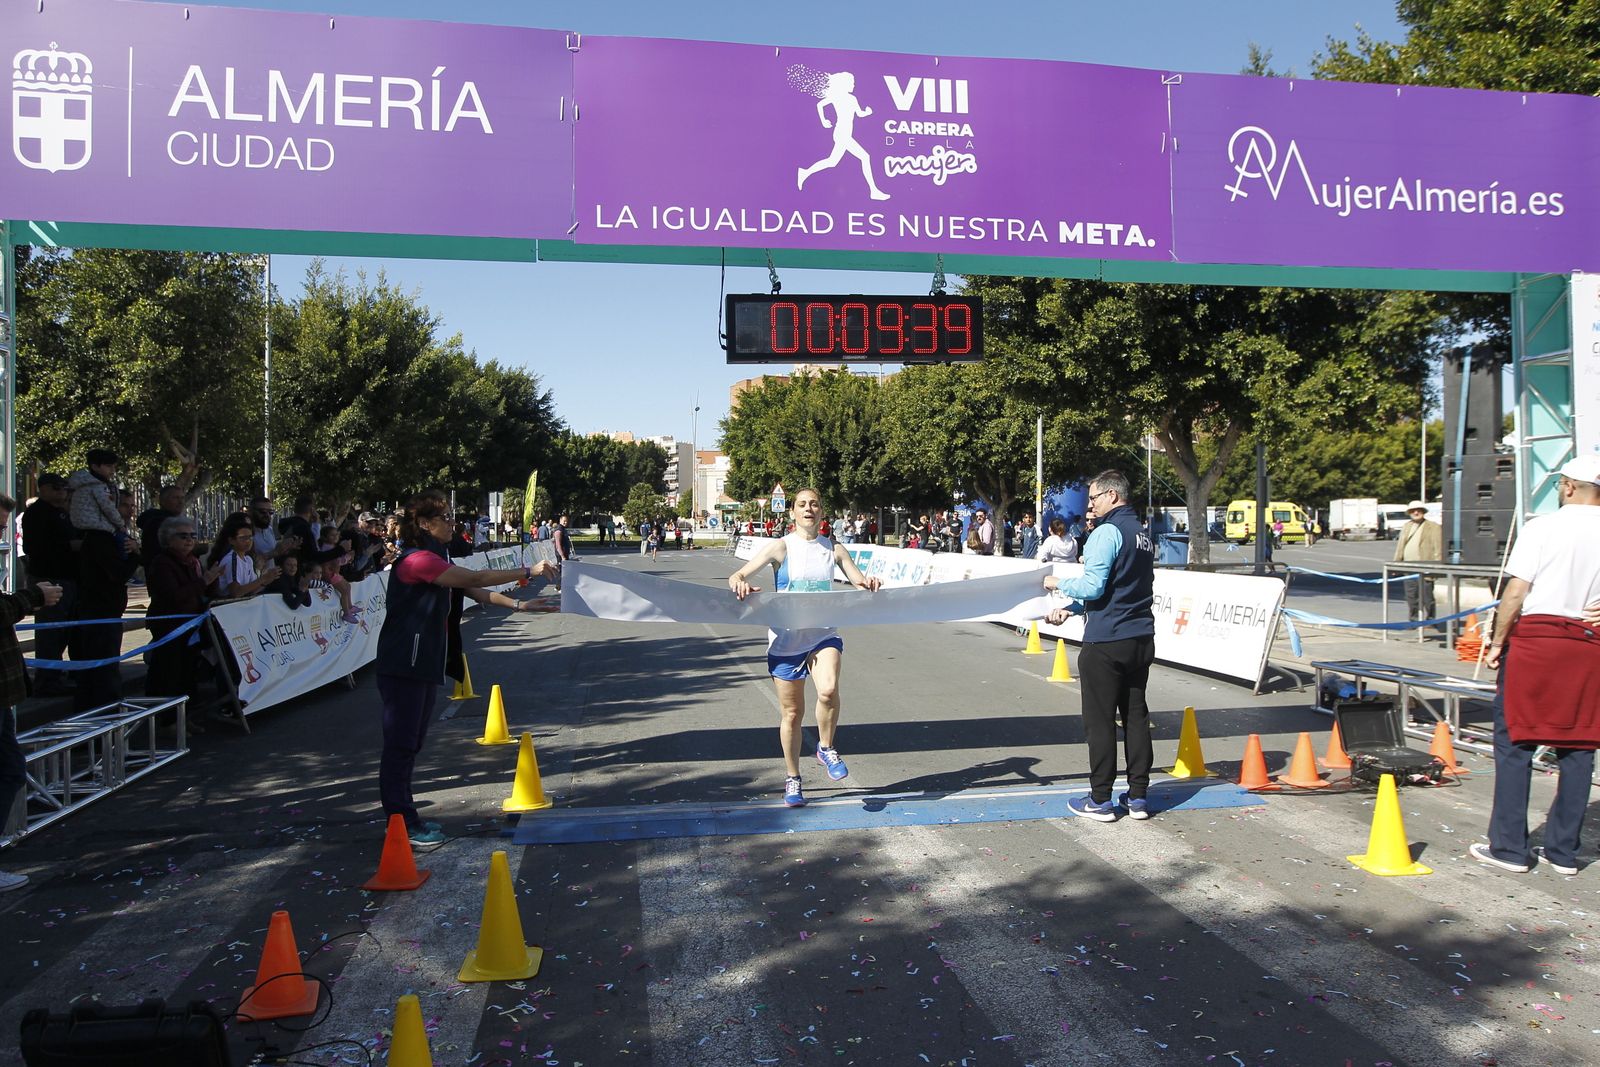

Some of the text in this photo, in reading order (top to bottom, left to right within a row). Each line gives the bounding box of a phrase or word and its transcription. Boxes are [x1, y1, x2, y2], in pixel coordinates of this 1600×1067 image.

[168, 65, 494, 135] ALMERÍA
[883, 75, 969, 114] VIII
[884, 120, 974, 137] CARRERA
[166, 131, 335, 172] CIUDAD
[595, 204, 1156, 248] LA IGUALDAD ES NUESTRA META.
[1203, 602, 1266, 628] ALMERÍA
